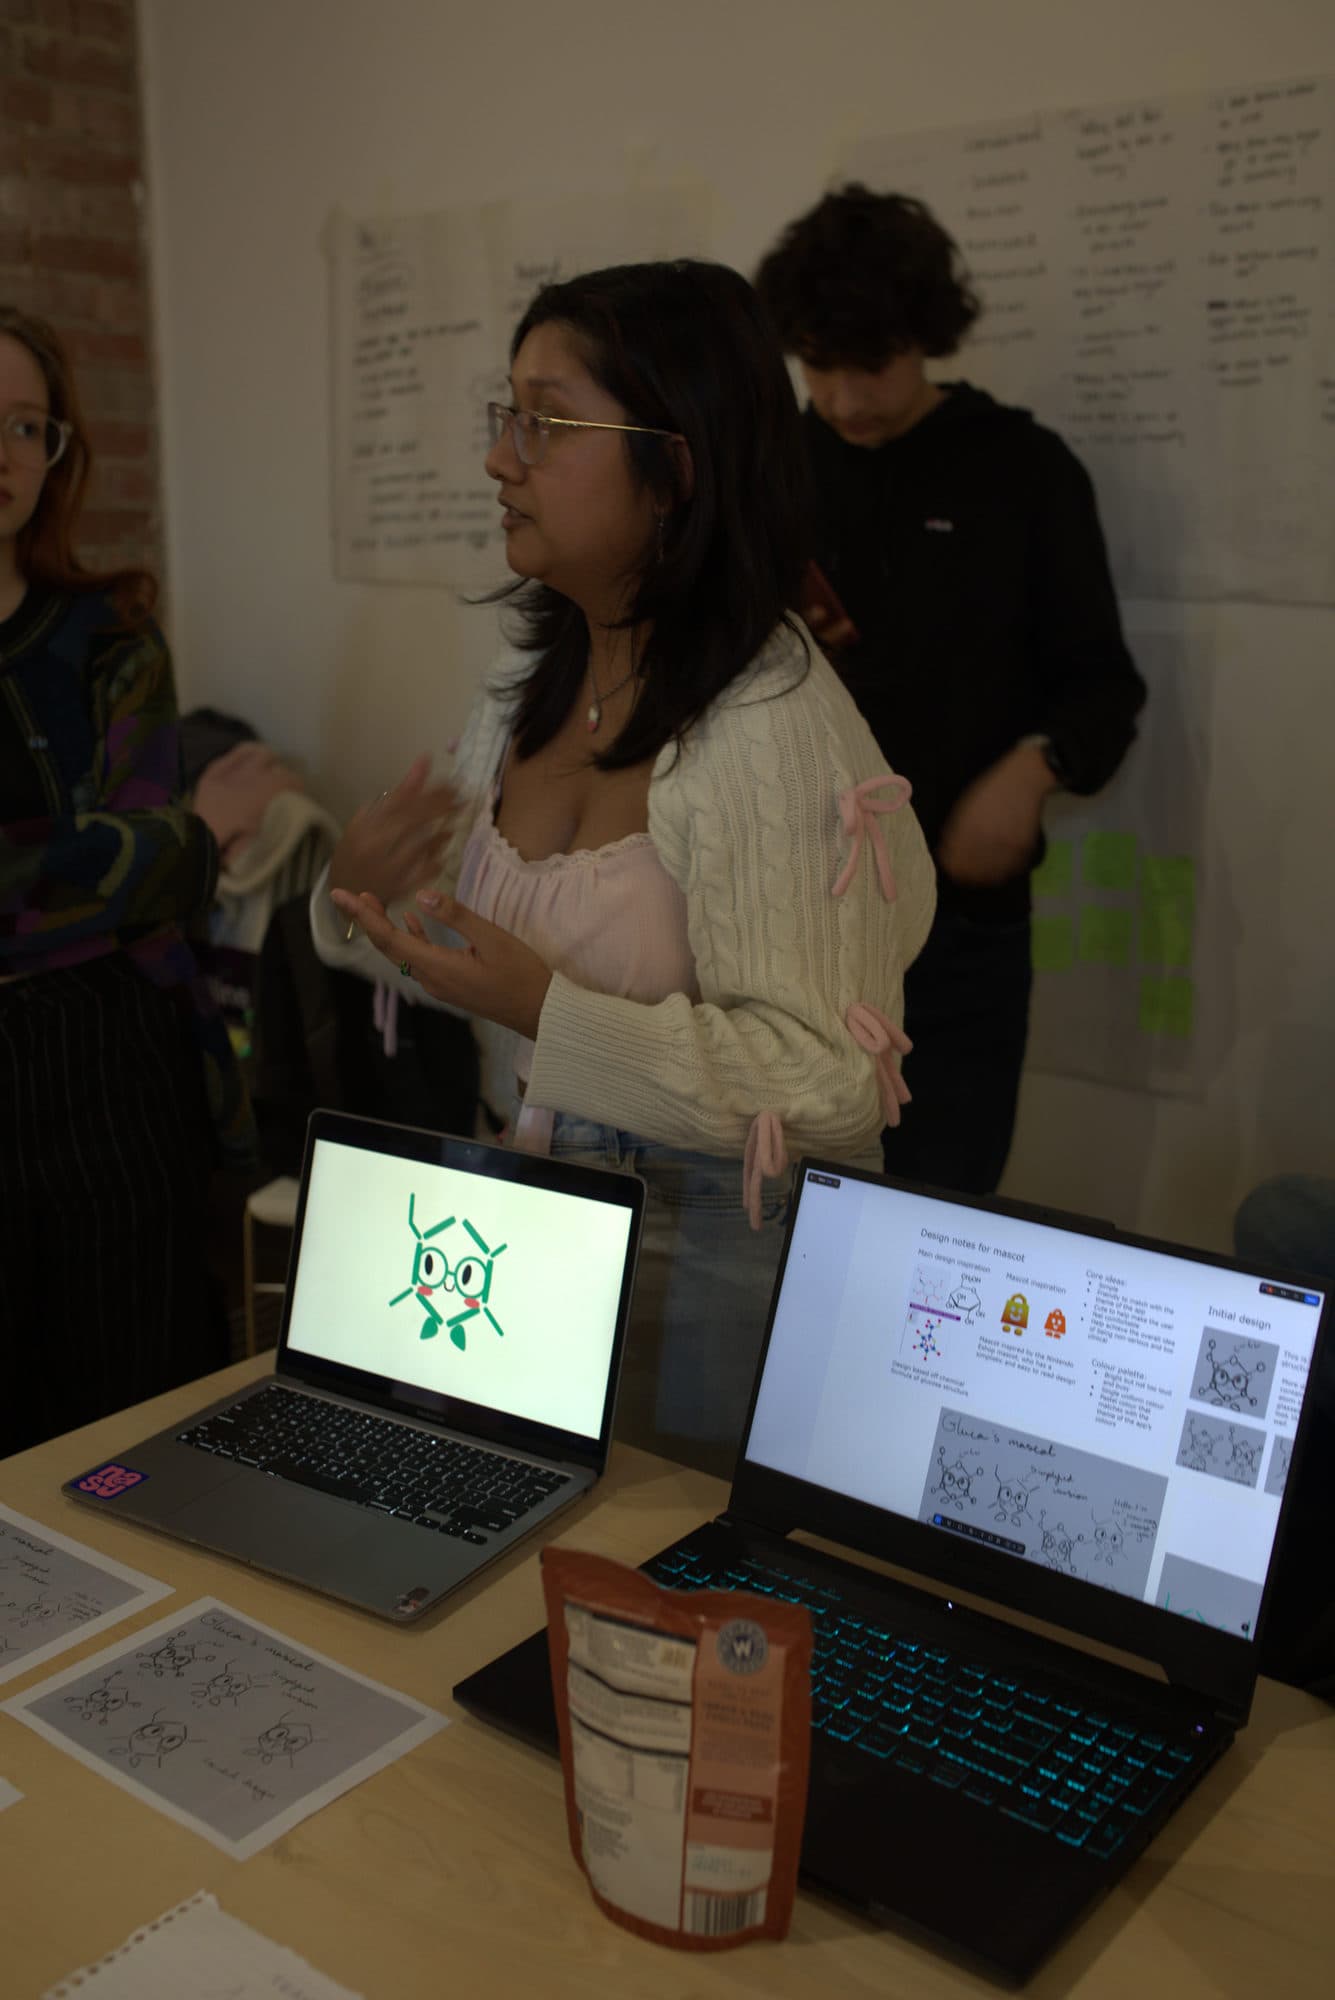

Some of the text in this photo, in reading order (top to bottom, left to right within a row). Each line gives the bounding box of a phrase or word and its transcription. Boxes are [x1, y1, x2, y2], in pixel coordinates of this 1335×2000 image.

[920, 1228, 1025, 1263] Design notes for mascot
[918, 1248, 991, 1274] Main design inspiration
[1086, 1270, 1104, 1281] Core
[1006, 1272, 1066, 1295] Mascot inspiration
[1123, 1303, 1133, 1312] the
[1163, 1306, 1175, 1315] the
[1148, 1318, 1159, 1327] the
[1208, 1306, 1272, 1331] Initial design
[1129, 1328, 1140, 1337] the
[979, 1335, 1074, 1368] Mascot inspired by the Nintendo
[1283, 1350, 1299, 1361] This
[1021, 1354, 1034, 1366] who
[1036, 1358, 1047, 1369] has
[1091, 1359, 1116, 1372] Colour
[892, 1360, 911, 1374] Design
[912, 1365, 930, 1377] based
[1056, 1373, 1076, 1386] design
[1135, 1381, 1146, 1389] not
[1124, 1416, 1135, 1425] the
[1138, 1412, 1150, 1421] the
[1008, 1437, 1057, 1458] mascot
[732, 1638, 753, 1658] W
[265, 1647, 314, 1672] mascot
